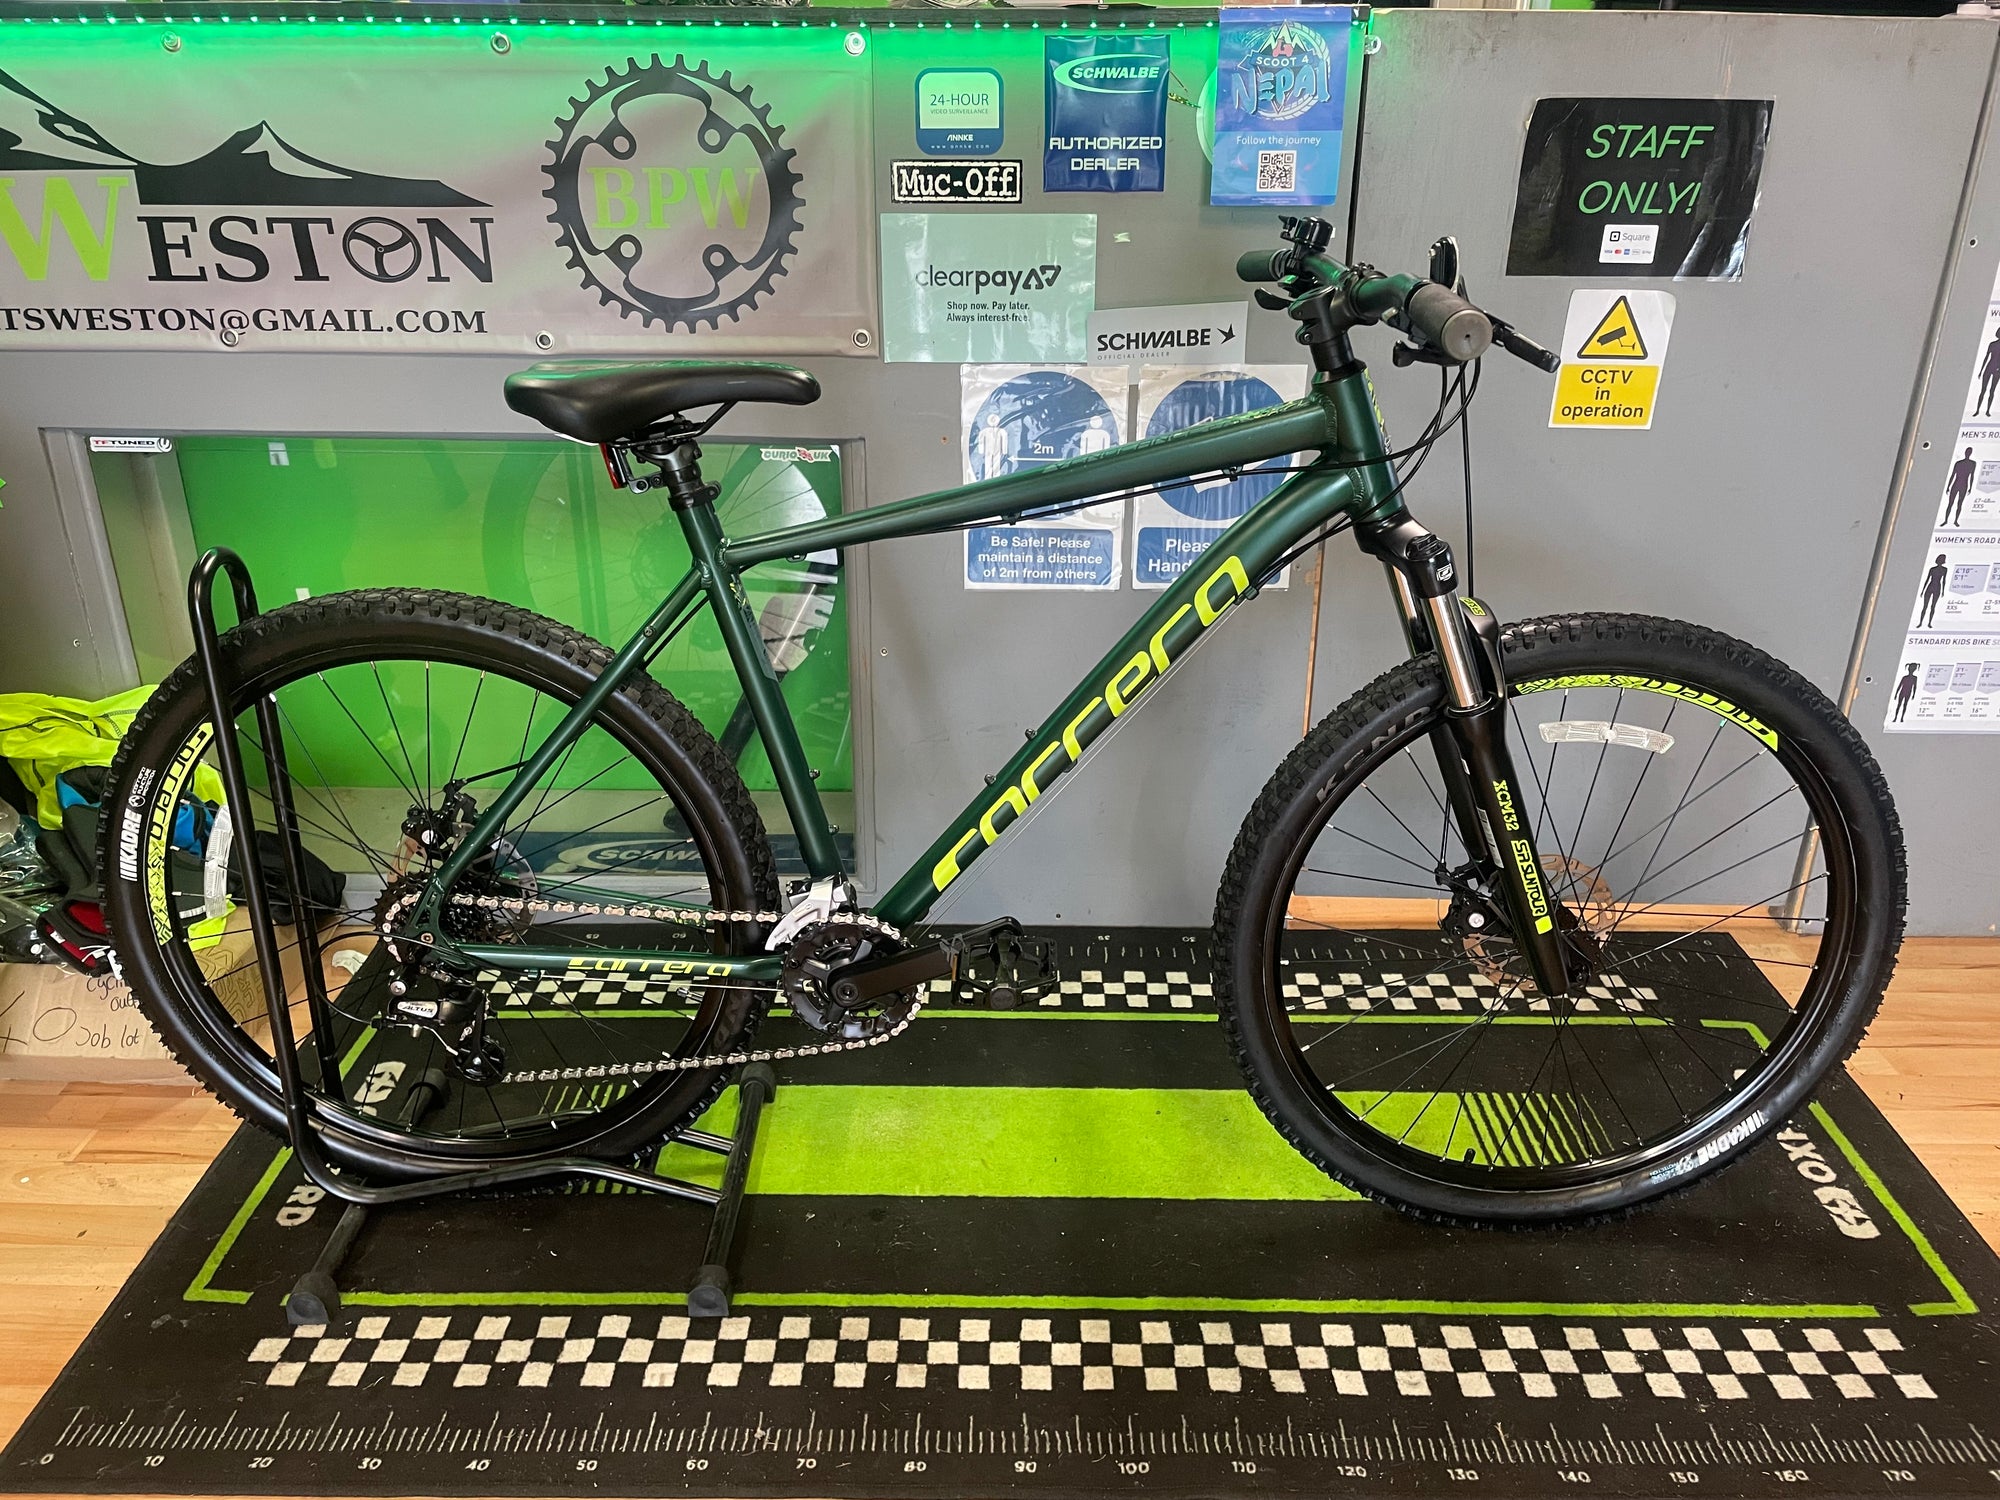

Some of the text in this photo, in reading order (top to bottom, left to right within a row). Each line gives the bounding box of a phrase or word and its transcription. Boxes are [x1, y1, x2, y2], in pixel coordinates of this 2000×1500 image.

[1255, 54, 1310, 67] SCOOT 4
[1071, 66, 1160, 80] SCHWALBE
[930, 93, 990, 106] 24-HOUR
[946, 134, 974, 142] ANNKE
[1049, 136, 1163, 151] AUTHORIZED
[1236, 135, 1322, 148] Follow the journey
[1585, 124, 1715, 159] STAFF
[1070, 157, 1141, 171] DEALER
[899, 166, 1016, 197] Muc-Off
[585, 167, 761, 230] BPW
[1577, 180, 1702, 215] ONLY!
[1622, 232, 1651, 243] Square
[915, 264, 1024, 296] clearpay
[946, 301, 968, 311] Shop
[992, 301, 1006, 311] Pay
[1009, 301, 1031, 311] later.
[0, 307, 488, 334] TSWESTON@GMAIL.COM
[946, 313, 975, 323] Always
[1097, 328, 1212, 352] SCHWALBE
[1097, 350, 1171, 361] OFFICIAL DEALER
[1580, 369, 1634, 384] CCTV
[1594, 386, 1610, 401] in
[1560, 403, 1645, 419] operation
[1961, 431, 1987, 439] MEN'S
[763, 450, 829, 460] CURIO UK
[1033, 442, 1055, 455] 2m
[990, 535, 1092, 549] Be Safe! Please
[1165, 538, 1212, 553] Pleas
[1934, 536, 1973, 544] WOMEN'S
[977, 552, 1103, 565] maintain a distance
[1148, 558, 1193, 573] Hand
[982, 567, 1098, 579] of 2m from others
[1908, 637, 1951, 646] STANDARD
[1952, 638, 1971, 646] KIDS
[1972, 638, 1991, 646] BIKE
[931, 554, 1250, 893] carrera
[1492, 779, 1520, 831] XCM32
[595, 848, 703, 861] SCHW
[86, 976, 126, 1001] cycli
[75, 1023, 139, 1049] Job lot
[39, 1452, 54, 1466] 0
[142, 1453, 165, 1468] 10
[248, 1456, 274, 1469] 20
[357, 1457, 382, 1470] 30
[465, 1459, 491, 1472] 40
[575, 1459, 599, 1472] 50
[685, 1459, 709, 1471] 60
[795, 1459, 818, 1472] 70
[902, 1460, 928, 1473] 80
[1013, 1460, 1038, 1473] 90
[1117, 1461, 1151, 1475] 100
[1336, 1465, 1368, 1479] 120
[1447, 1467, 1480, 1481] 130
[1557, 1469, 1592, 1484] 140
[1667, 1469, 1701, 1484] 150
[1773, 1468, 1810, 1484] 160
[1881, 1469, 1918, 1481] 170
